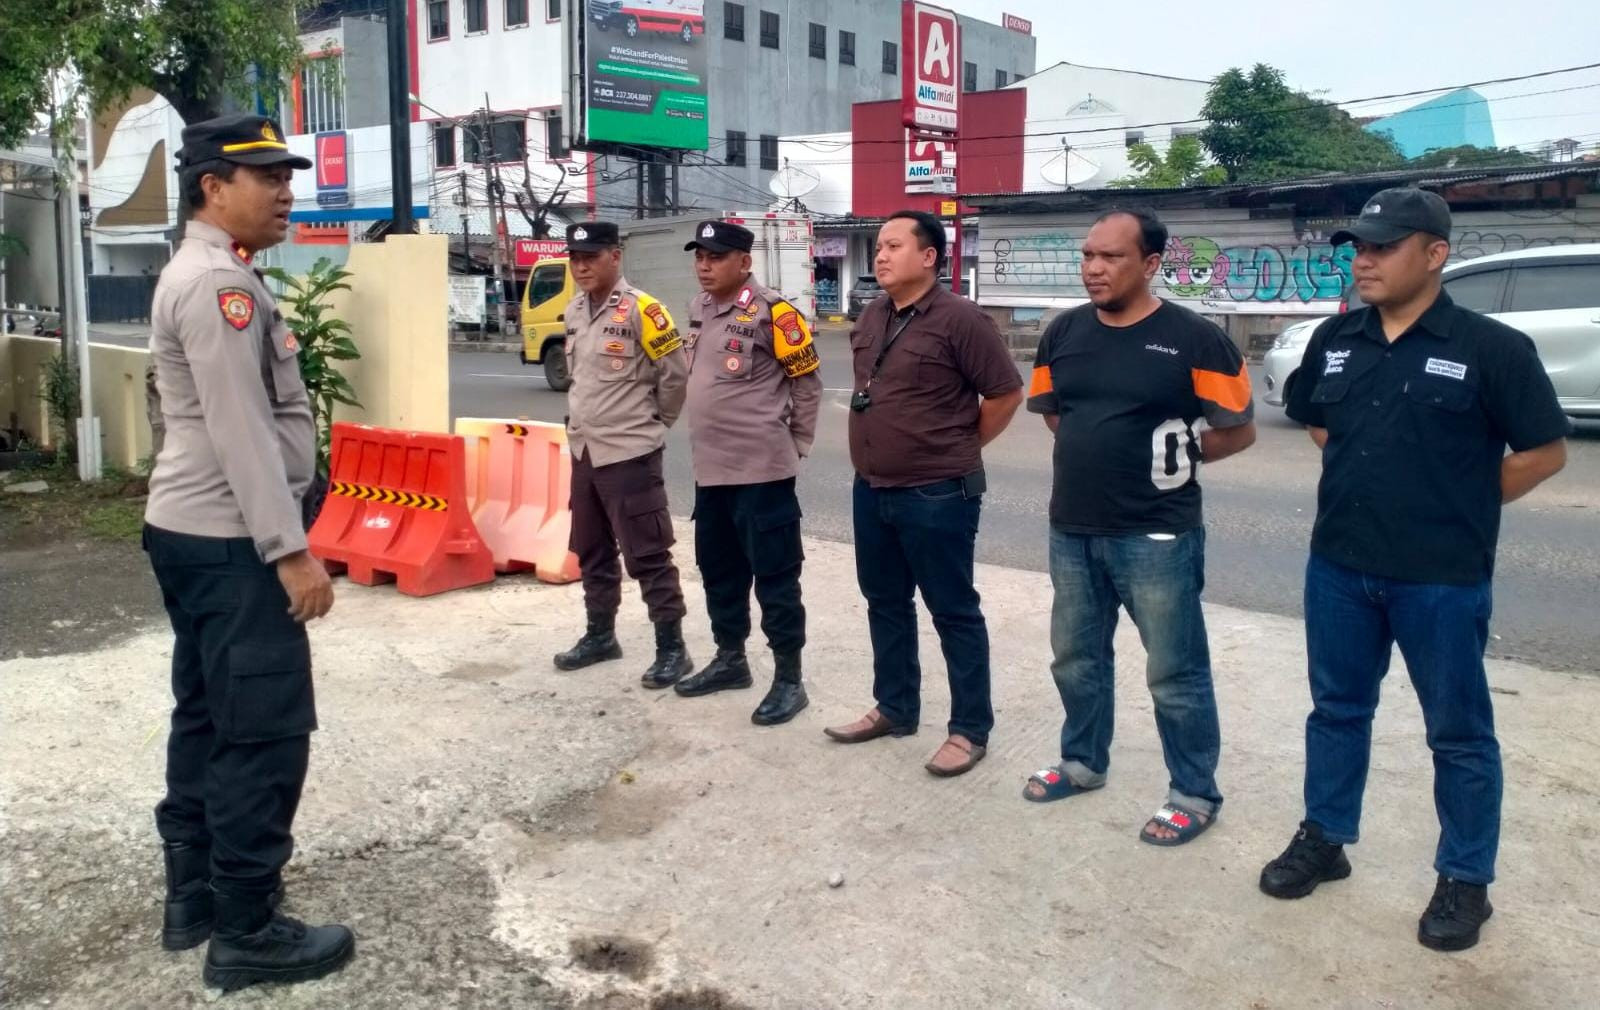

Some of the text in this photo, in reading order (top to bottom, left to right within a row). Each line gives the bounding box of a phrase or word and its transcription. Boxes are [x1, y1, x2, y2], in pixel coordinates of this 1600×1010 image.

[1008, 17, 1030, 32] DENSO
[918, 85, 954, 104] Alfamidi
[603, 326, 632, 338] POLRI
[724, 323, 755, 338] POLRI
[1145, 344, 1169, 353] adidas
